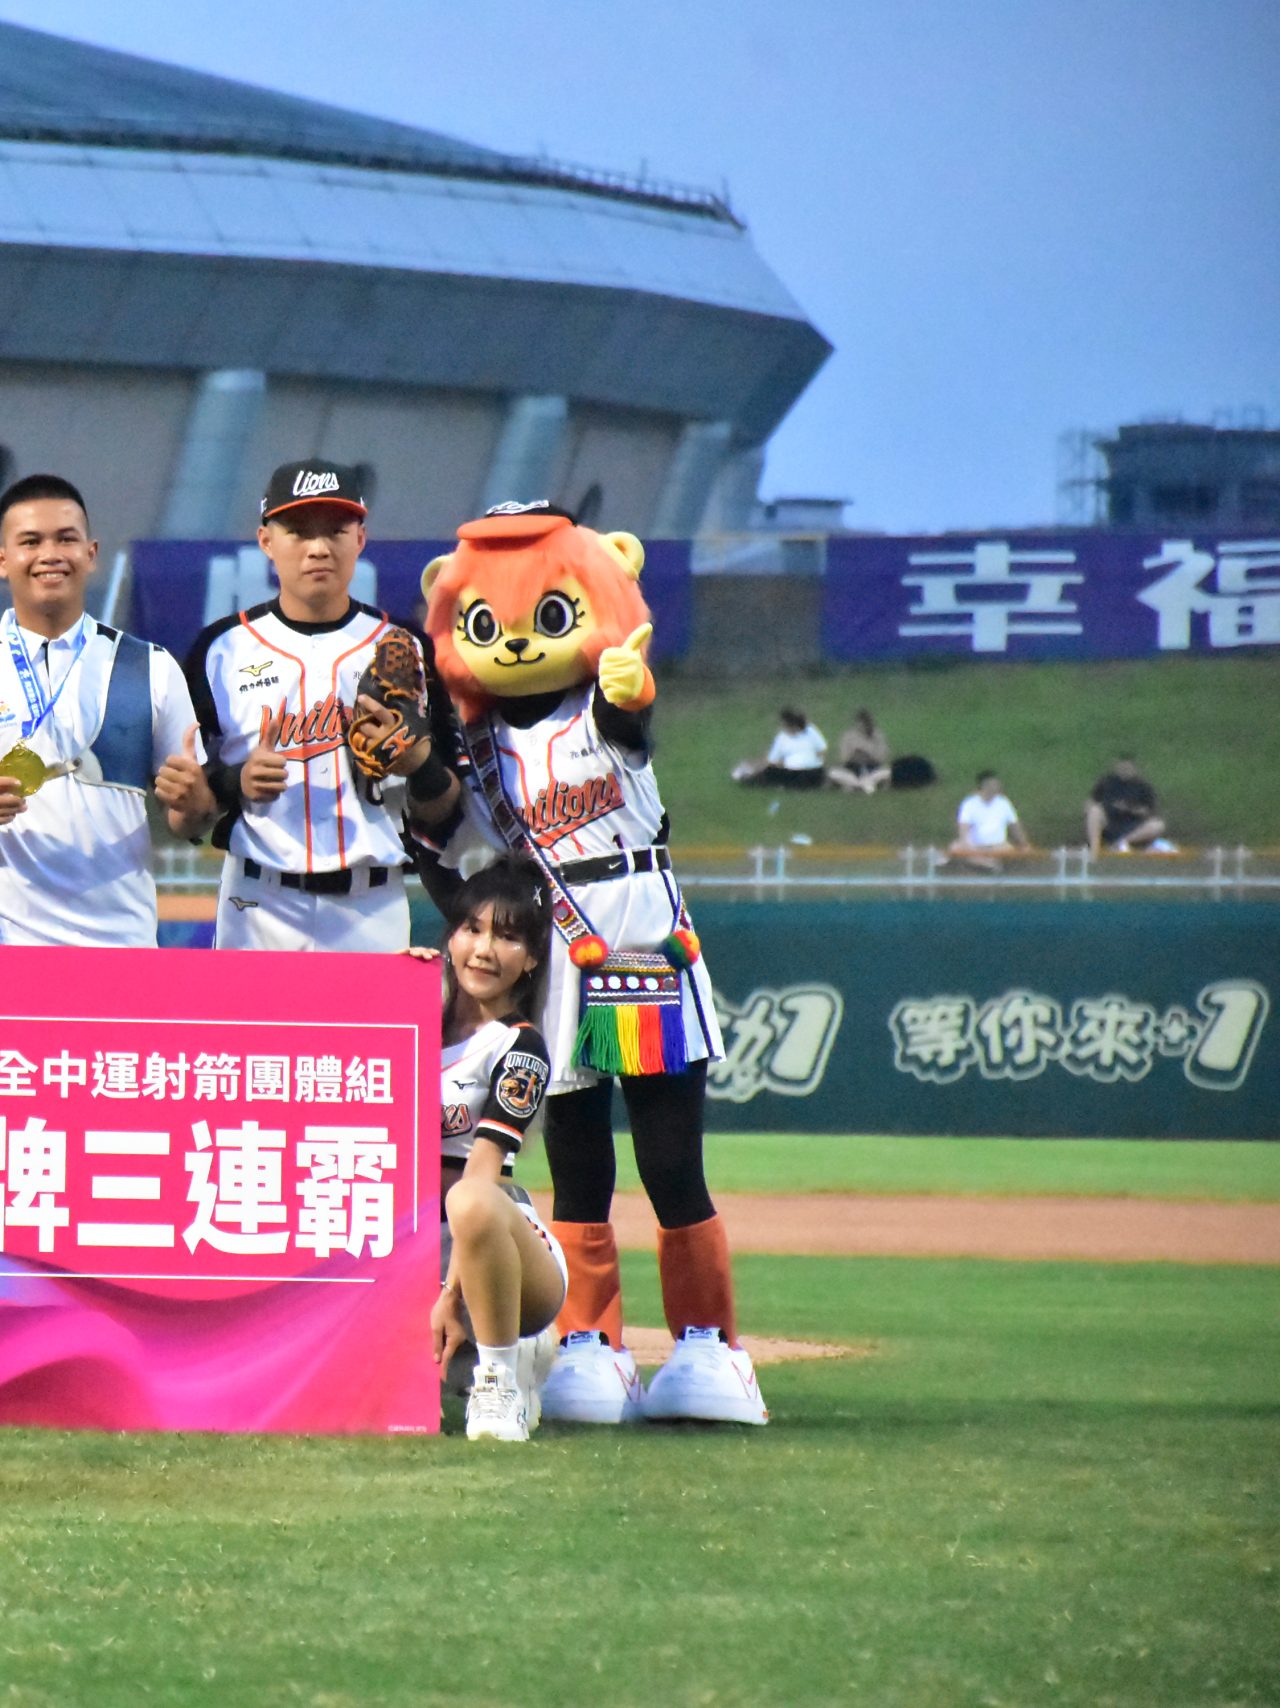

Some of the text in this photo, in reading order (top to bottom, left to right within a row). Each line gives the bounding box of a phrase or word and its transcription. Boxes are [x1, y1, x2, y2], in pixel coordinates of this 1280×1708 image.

[293, 470, 340, 497] Lions
[517, 773, 625, 836] nilions
[890, 980, 1267, 1088] 等你來+1
